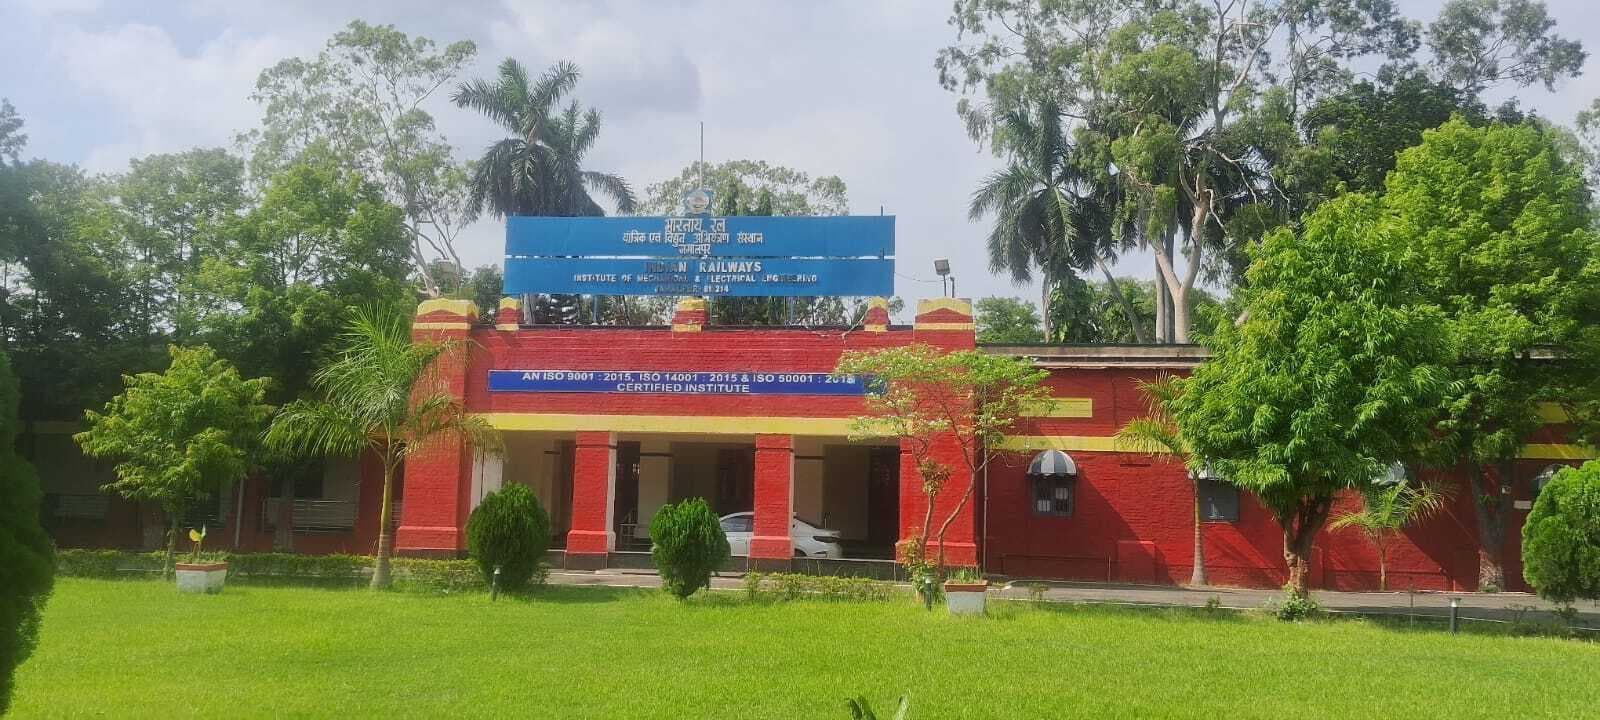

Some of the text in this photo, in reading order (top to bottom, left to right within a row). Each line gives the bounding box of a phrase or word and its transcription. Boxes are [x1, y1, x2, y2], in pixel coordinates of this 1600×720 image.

[699, 261, 762, 273] RAILWAYS
[574, 274, 617, 283] INSTITUTE
[621, 274, 633, 283] OF
[637, 274, 688, 284] MECHCAL
[707, 274, 756, 283] LECTRICAL
[522, 372, 540, 381] AN
[543, 372, 564, 381] ISO
[567, 373, 594, 381] 9001
[603, 373, 634, 382] 2015,
[639, 373, 661, 382] ISO
[665, 373, 697, 382] 14001
[709, 373, 738, 382] 2015
[741, 374, 749, 383] &
[753, 374, 775, 383] ISO
[778, 374, 813, 383] 50001
[616, 383, 750, 393] CERTIFIED INSTITUTE
